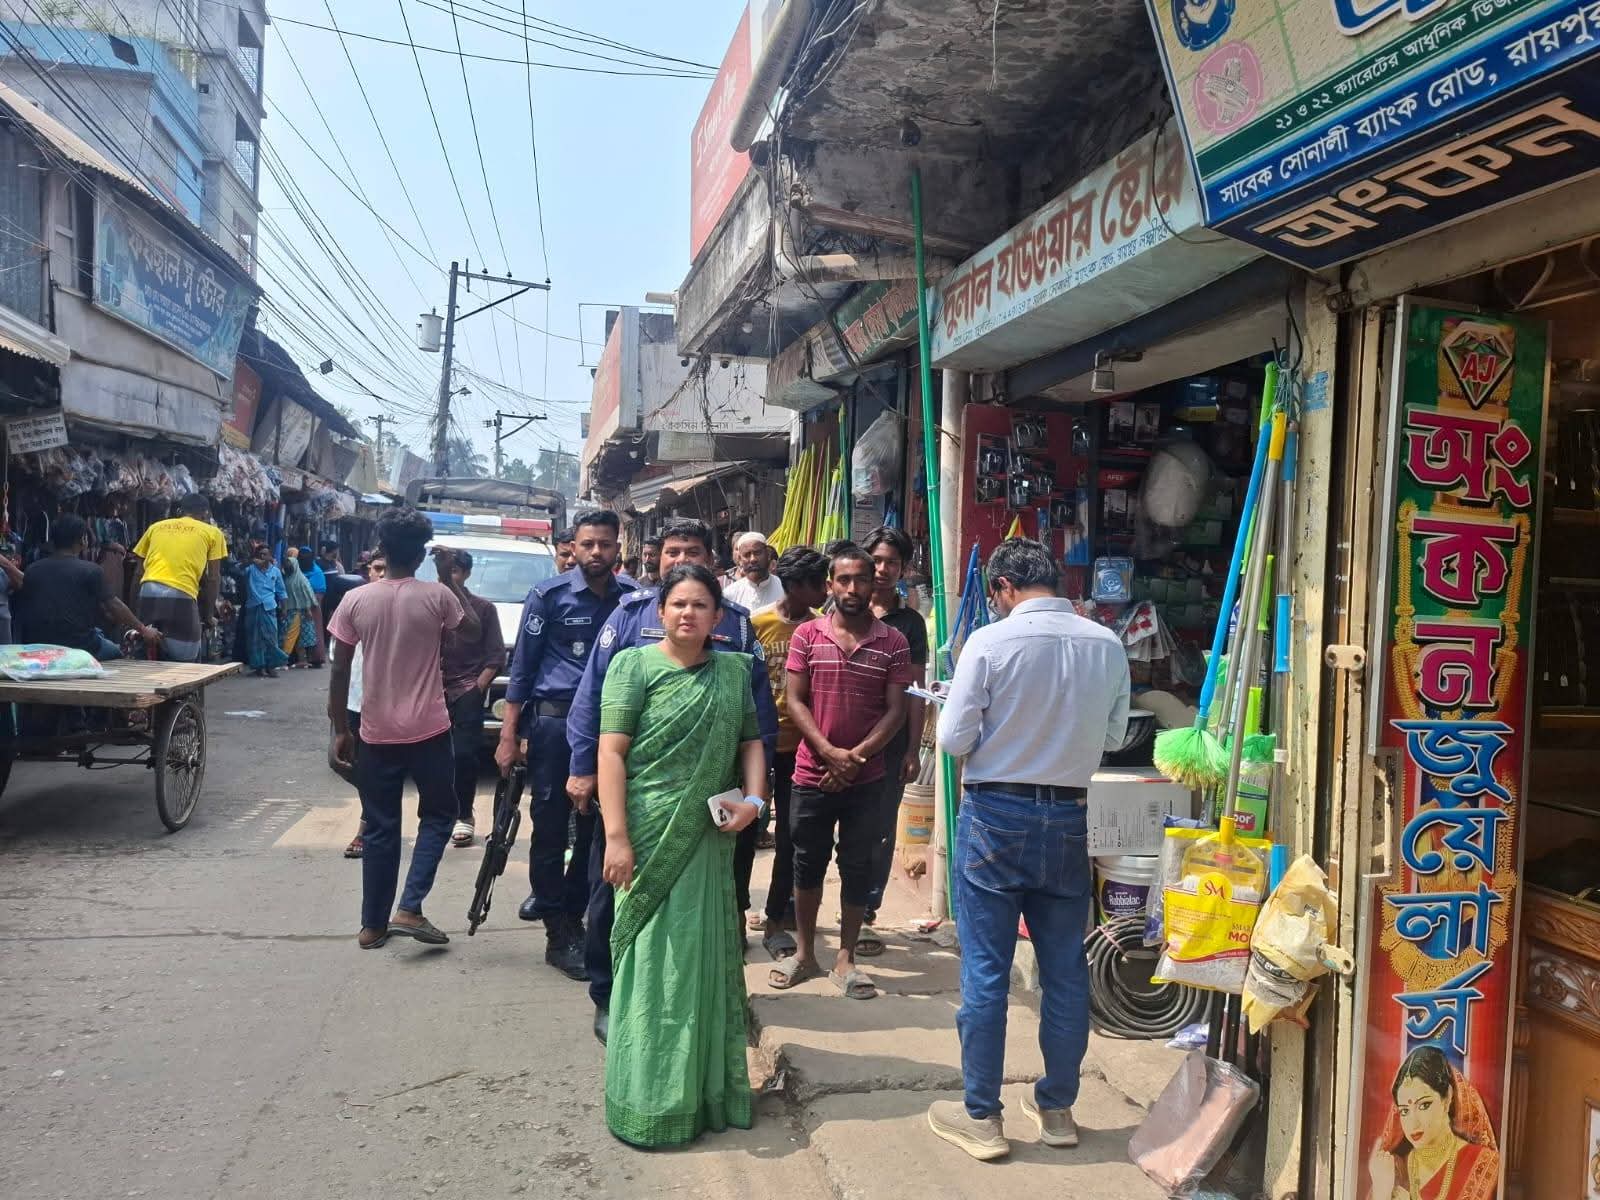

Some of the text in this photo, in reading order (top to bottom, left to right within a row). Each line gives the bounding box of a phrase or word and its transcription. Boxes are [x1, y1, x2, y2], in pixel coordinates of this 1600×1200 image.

[1275, 113, 1293, 129] ২১
[1296, 104, 1308, 117] ও
[1312, 92, 1334, 109] ২২
[1333, 51, 1399, 95] ক্যারেটের
[1402, 13, 1467, 57] আধুনিক
[1219, 165, 1273, 204] সাবেক
[1279, 125, 1350, 179] সোনালী
[1353, 91, 1419, 137] ব্যাংক
[1427, 58, 1498, 108] রোড,
[1252, 96, 1600, 247] অংকন
[944, 257, 994, 338] দুলাল
[1460, 352, 1497, 384] AJ
